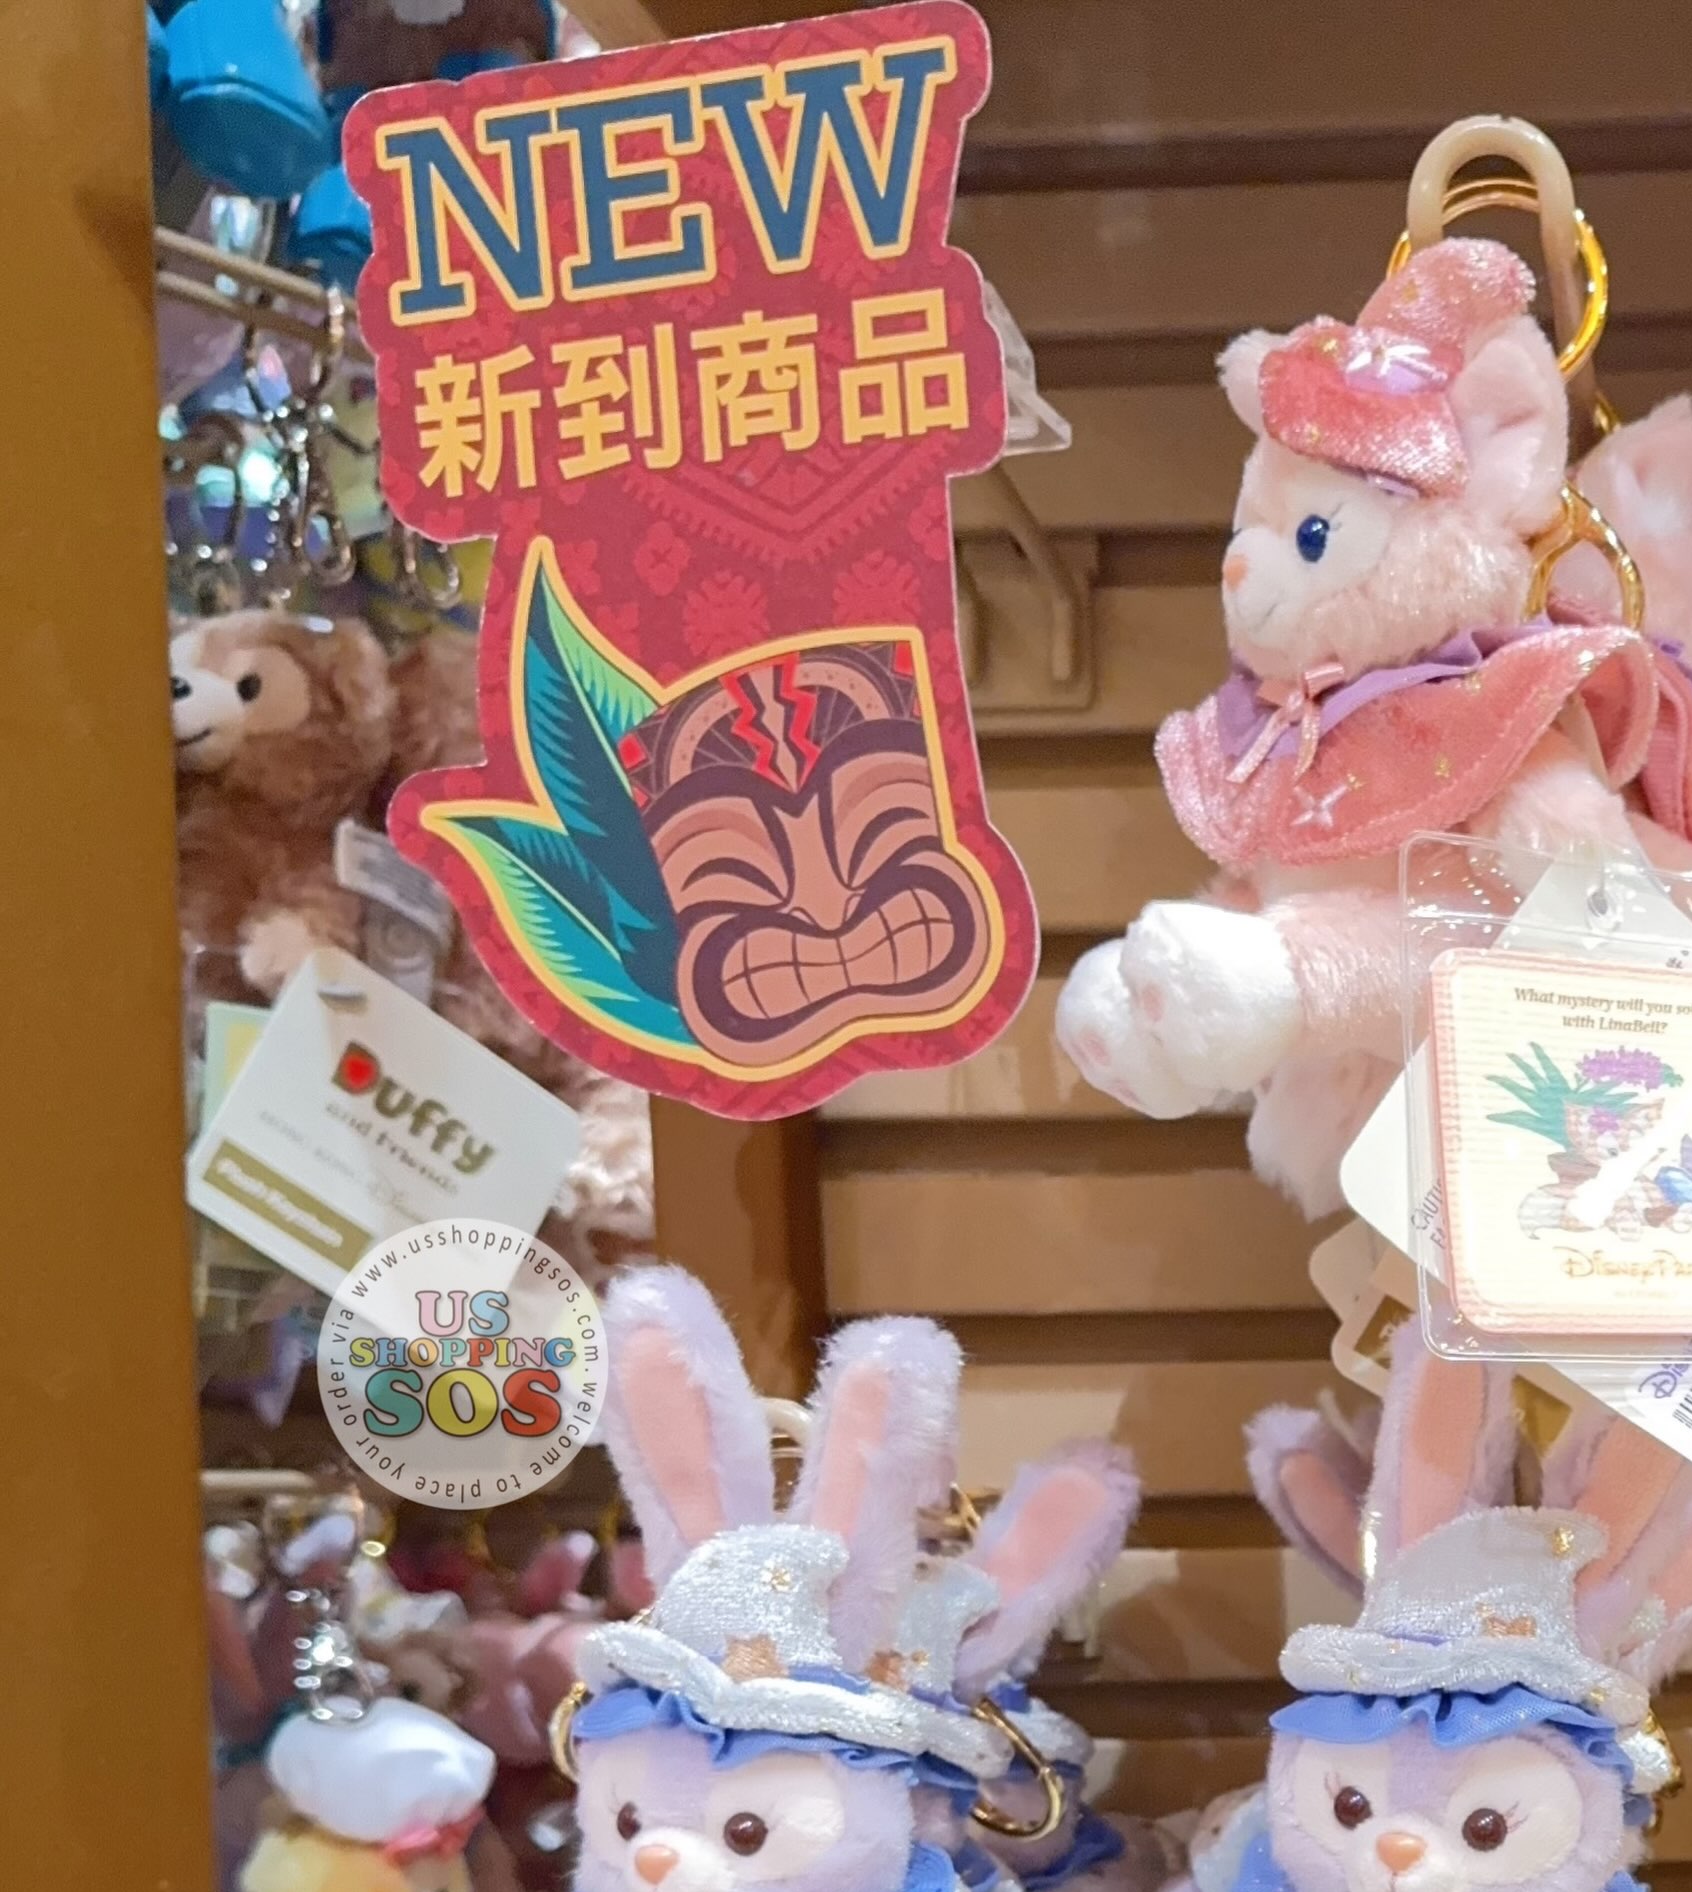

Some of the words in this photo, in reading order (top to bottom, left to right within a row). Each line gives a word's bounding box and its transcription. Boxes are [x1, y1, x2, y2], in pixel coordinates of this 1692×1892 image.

[375, 36, 959, 326] NEW
[414, 288, 969, 498] 新到商品
[1514, 987, 1554, 1005] What
[1557, 993, 1614, 1013] mystery
[1617, 998, 1644, 1012] will
[1646, 1002, 1672, 1016] you
[1562, 1014, 1595, 1029] with
[1599, 1017, 1668, 1034] LinaBell?
[331, 1040, 496, 1175] Duffy
[1411, 1179, 1441, 1230] CAUTI
